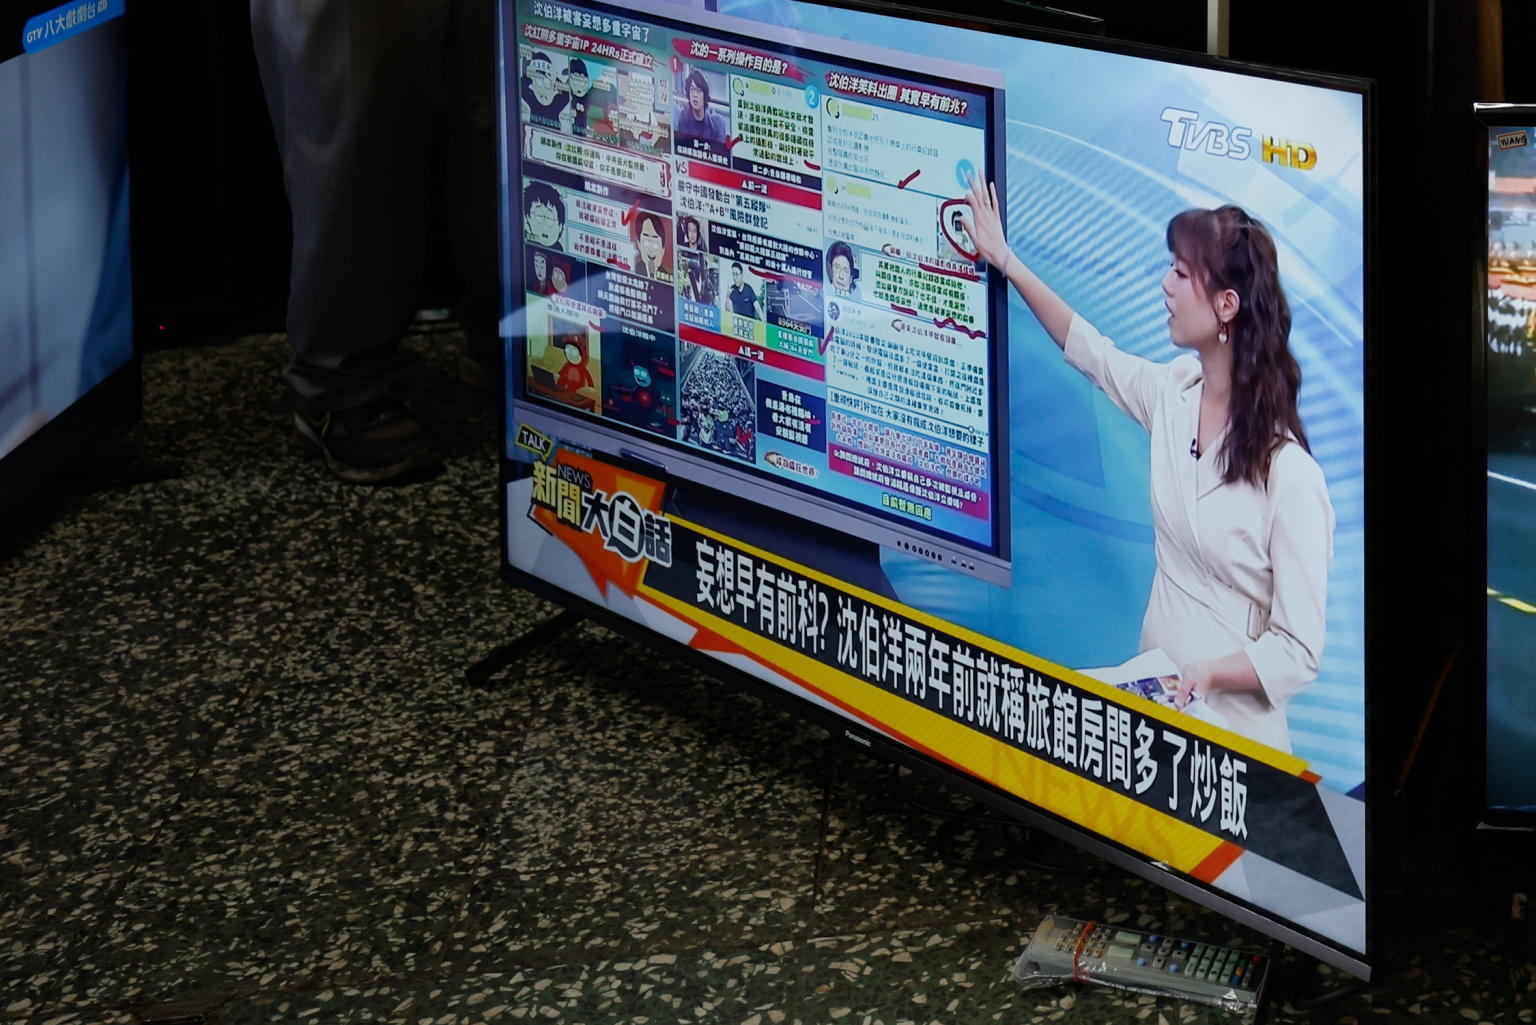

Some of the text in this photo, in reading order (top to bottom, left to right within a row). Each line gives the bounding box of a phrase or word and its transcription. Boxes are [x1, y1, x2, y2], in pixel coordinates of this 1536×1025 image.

[1160, 106, 1318, 171] TVBS HD
[522, 430, 546, 452] TALK
[557, 463, 591, 489] NEWS
[532, 459, 672, 568] 新聞大白話
[695, 539, 1248, 842] 妄想早有前科? 沈伯洋兩年前就稱旅館房間多了炒飯
